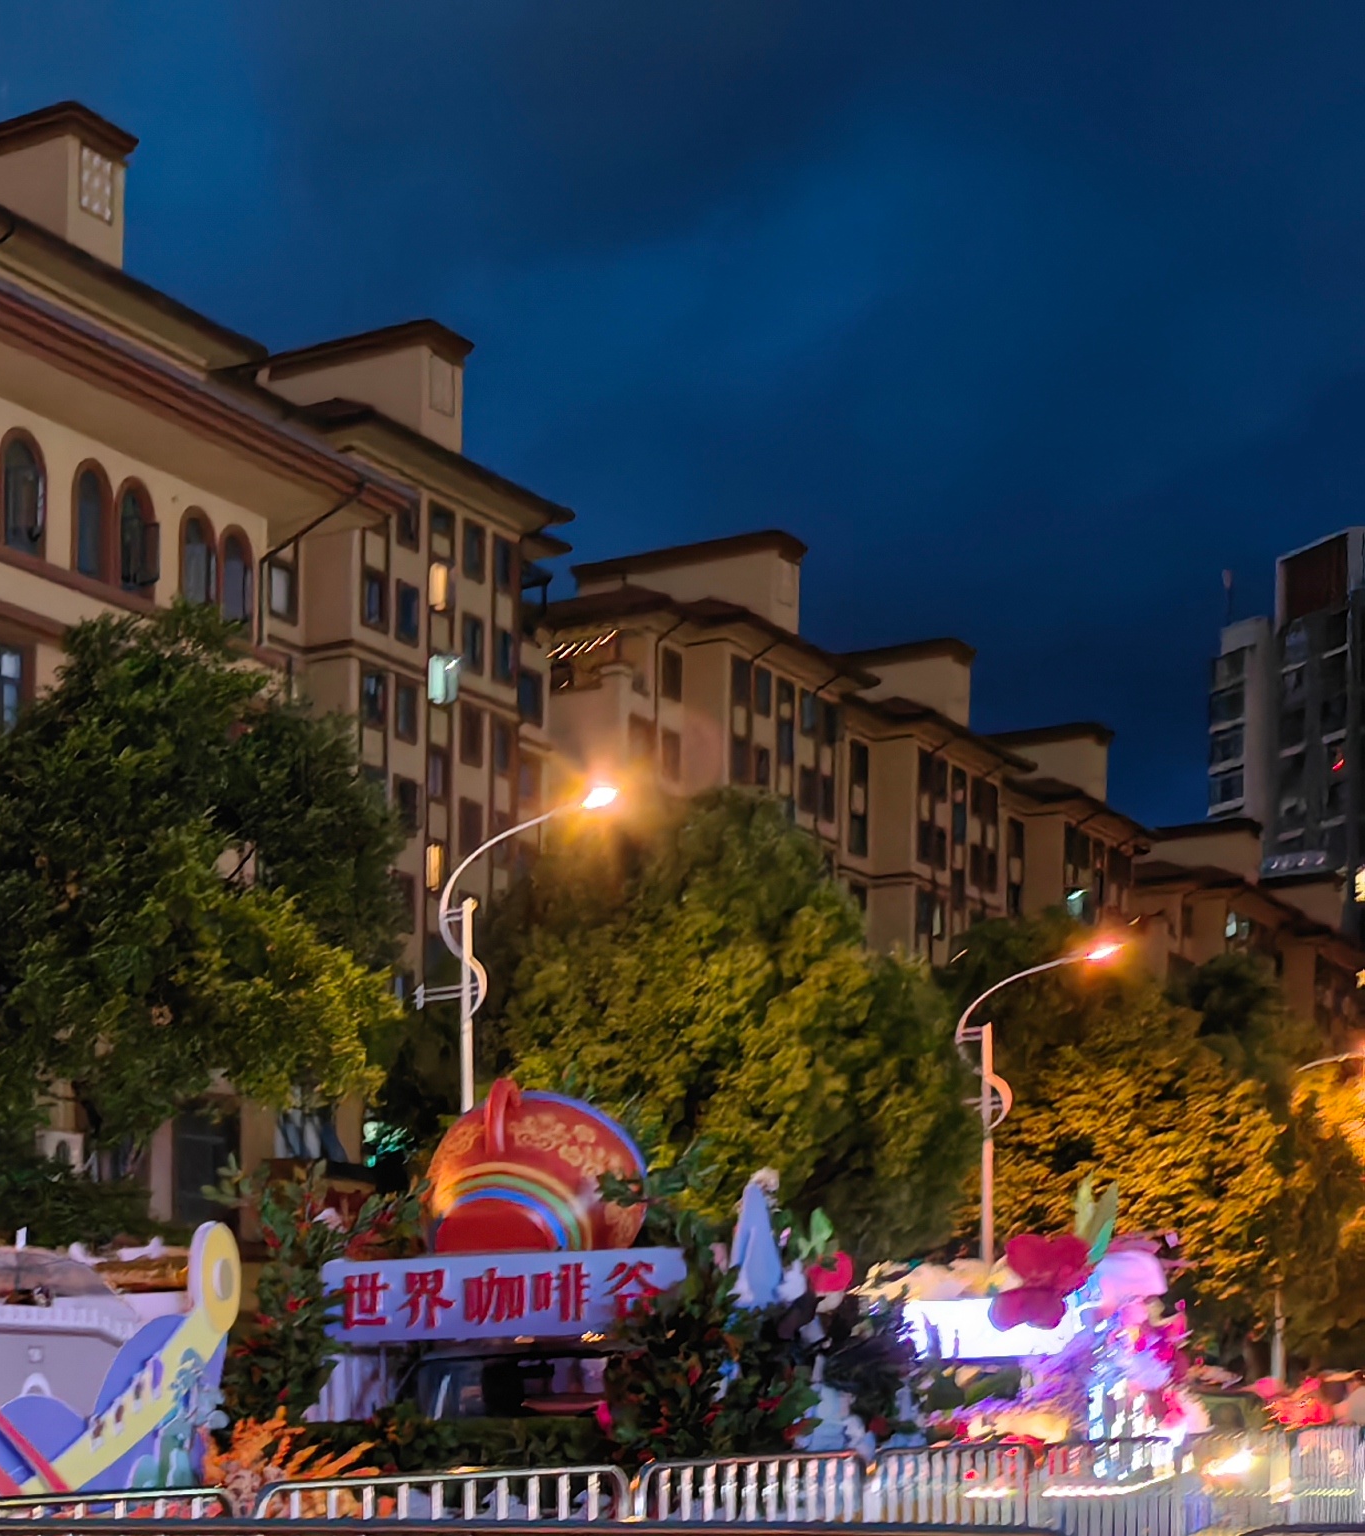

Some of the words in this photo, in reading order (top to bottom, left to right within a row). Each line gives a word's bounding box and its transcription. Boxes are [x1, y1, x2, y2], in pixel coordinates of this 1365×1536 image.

[339, 1261, 667, 1330] 世界咖啡谷
